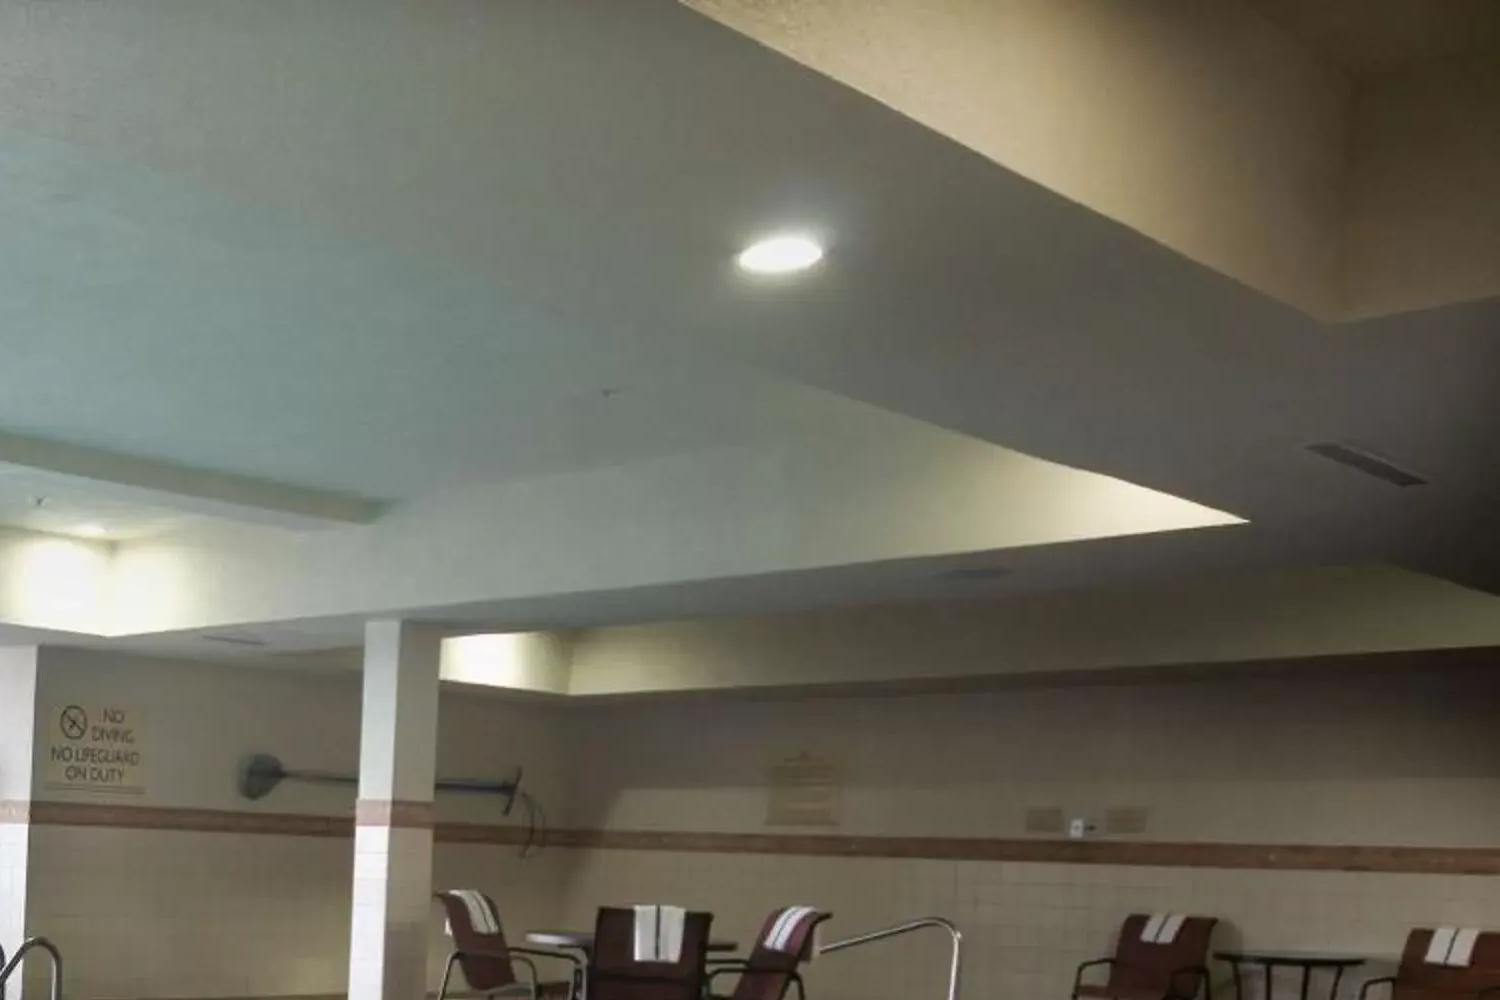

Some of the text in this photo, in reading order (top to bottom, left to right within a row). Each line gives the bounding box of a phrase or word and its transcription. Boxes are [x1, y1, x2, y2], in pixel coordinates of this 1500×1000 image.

[103, 708, 125, 723] NO
[91, 725, 135, 744] DIVING
[51, 745, 140, 767] NO LIFEGUARD
[65, 765, 124, 784] ON DUTY
